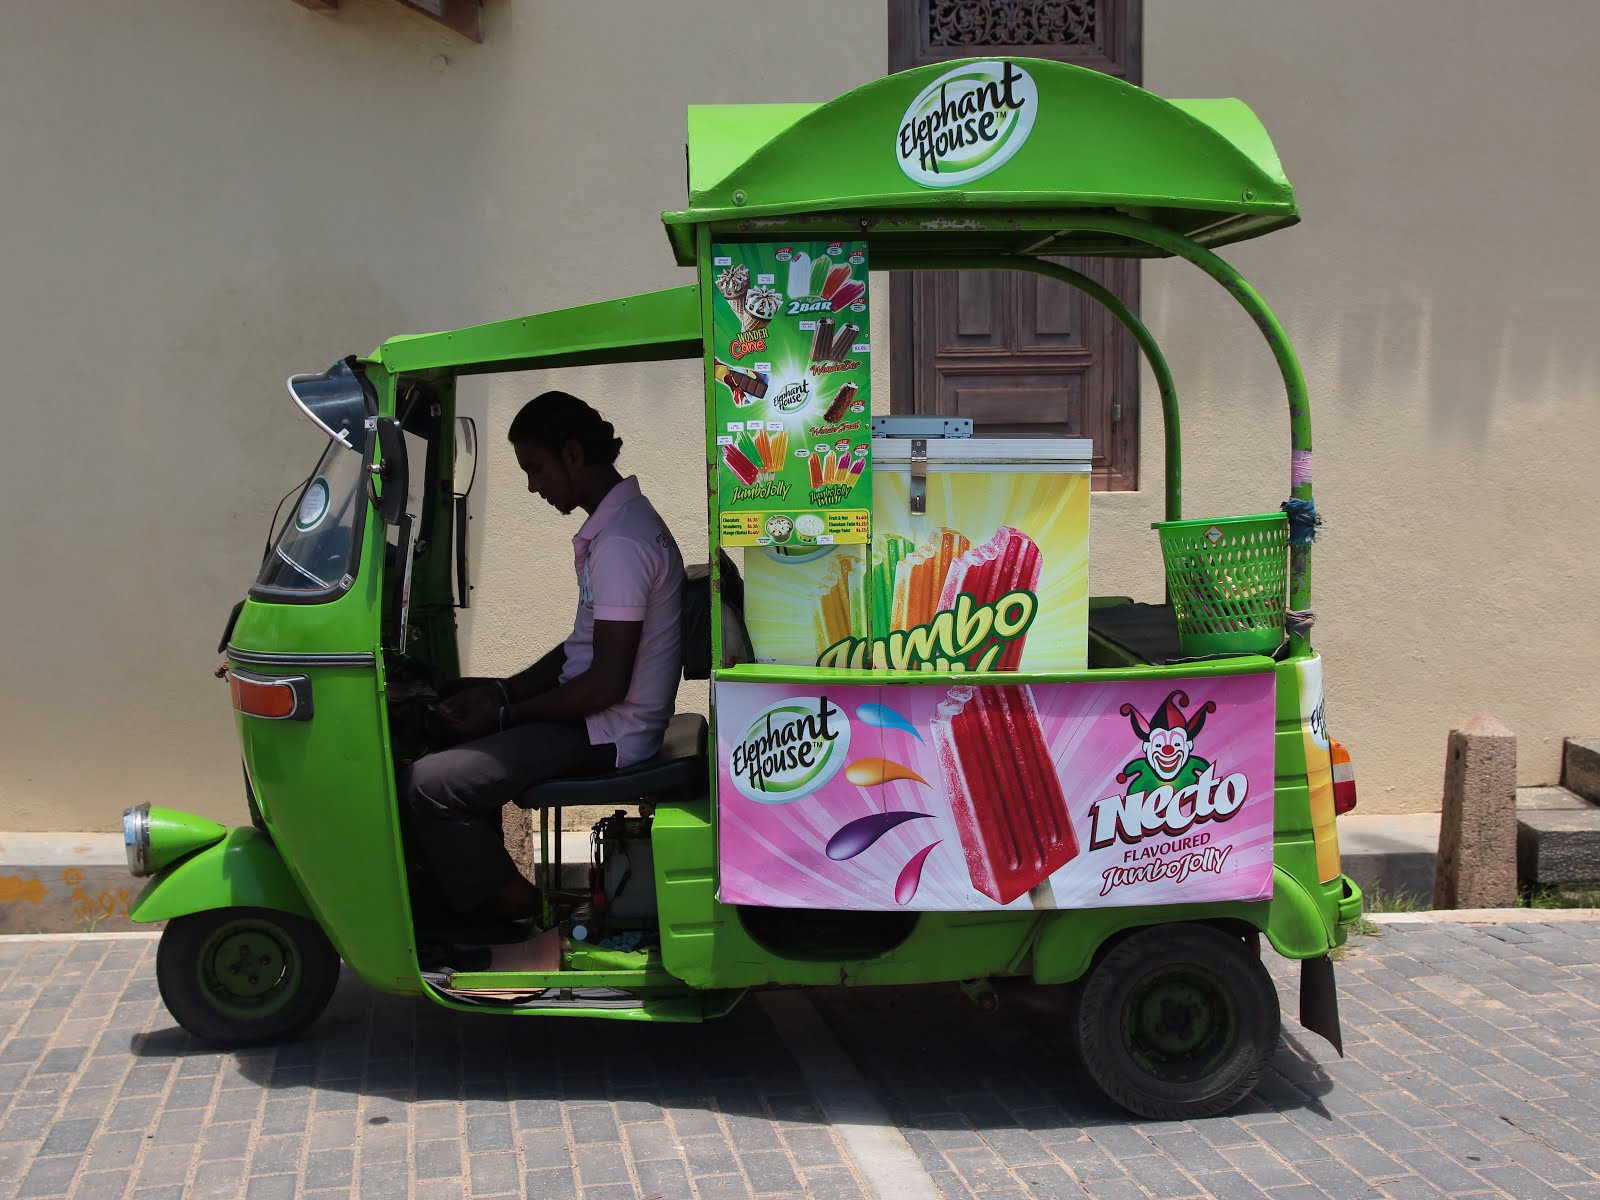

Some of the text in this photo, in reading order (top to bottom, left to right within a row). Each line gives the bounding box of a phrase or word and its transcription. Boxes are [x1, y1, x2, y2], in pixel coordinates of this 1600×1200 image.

[900, 61, 1025, 159] Elephant
[919, 111, 998, 174] House
[730, 339, 767, 360] Cone
[737, 328, 769, 343] WONDER
[773, 379, 810, 407] Elephant
[779, 392, 802, 411] House
[733, 695, 839, 777] Elephant
[749, 740, 815, 792] House
[1088, 760, 1249, 852] Necto
[1099, 845, 1233, 896] JumboJolly
[1123, 832, 1211, 863] FLAVOURED
